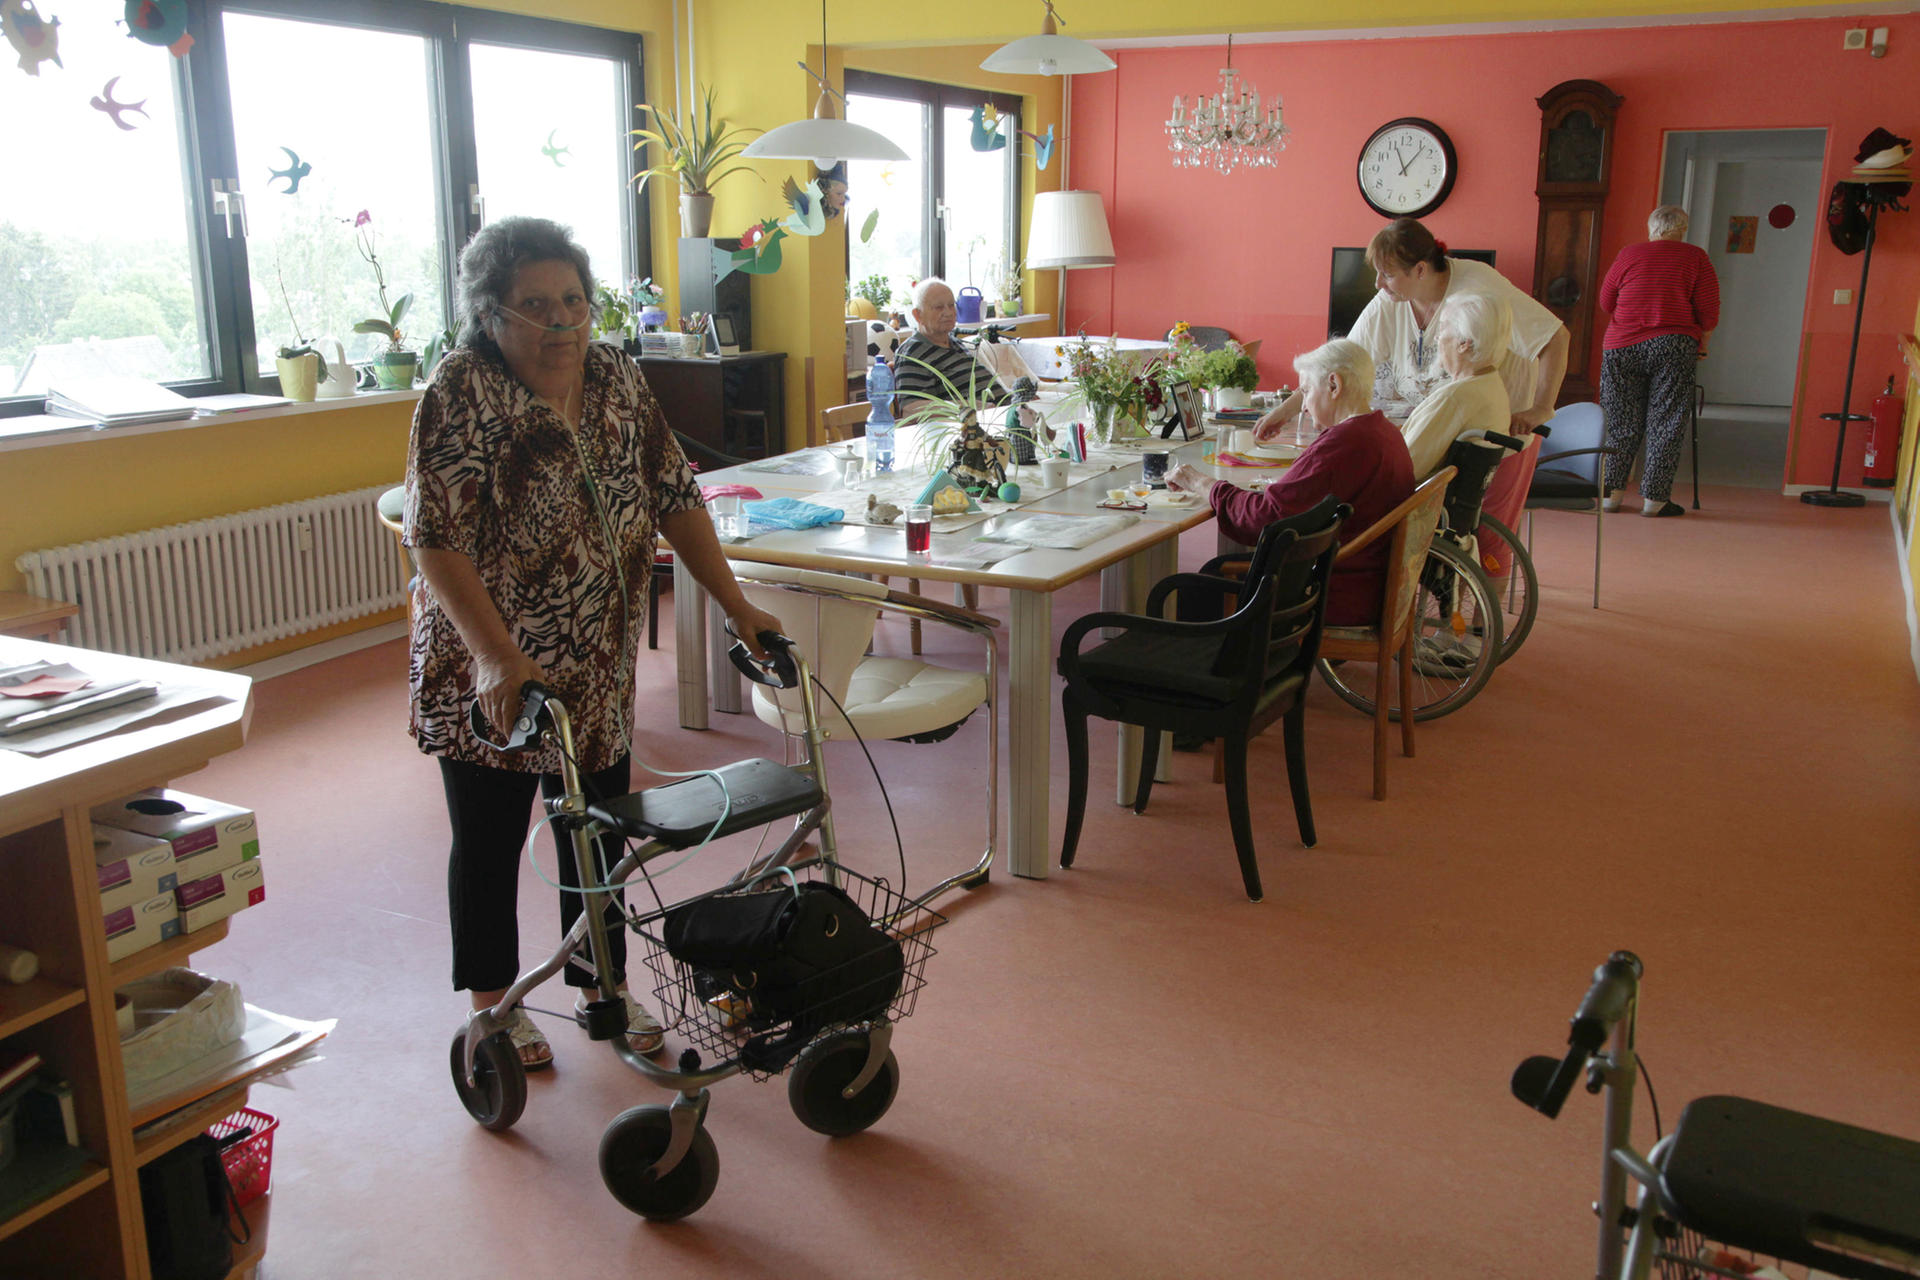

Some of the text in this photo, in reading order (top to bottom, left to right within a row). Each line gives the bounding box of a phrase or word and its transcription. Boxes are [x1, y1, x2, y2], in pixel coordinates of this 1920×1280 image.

[1388, 140, 1397, 151] 11
[1400, 135, 1412, 146] 12
[1378, 152, 1389, 162] 10
[1426, 148, 1433, 160] 2
[1372, 165, 1380, 173] 9
[1432, 164, 1438, 175] 3
[1376, 179, 1383, 189] 8
[1424, 179, 1431, 188] 4
[1387, 189, 1393, 199] 7
[1399, 193, 1405, 203] 6
